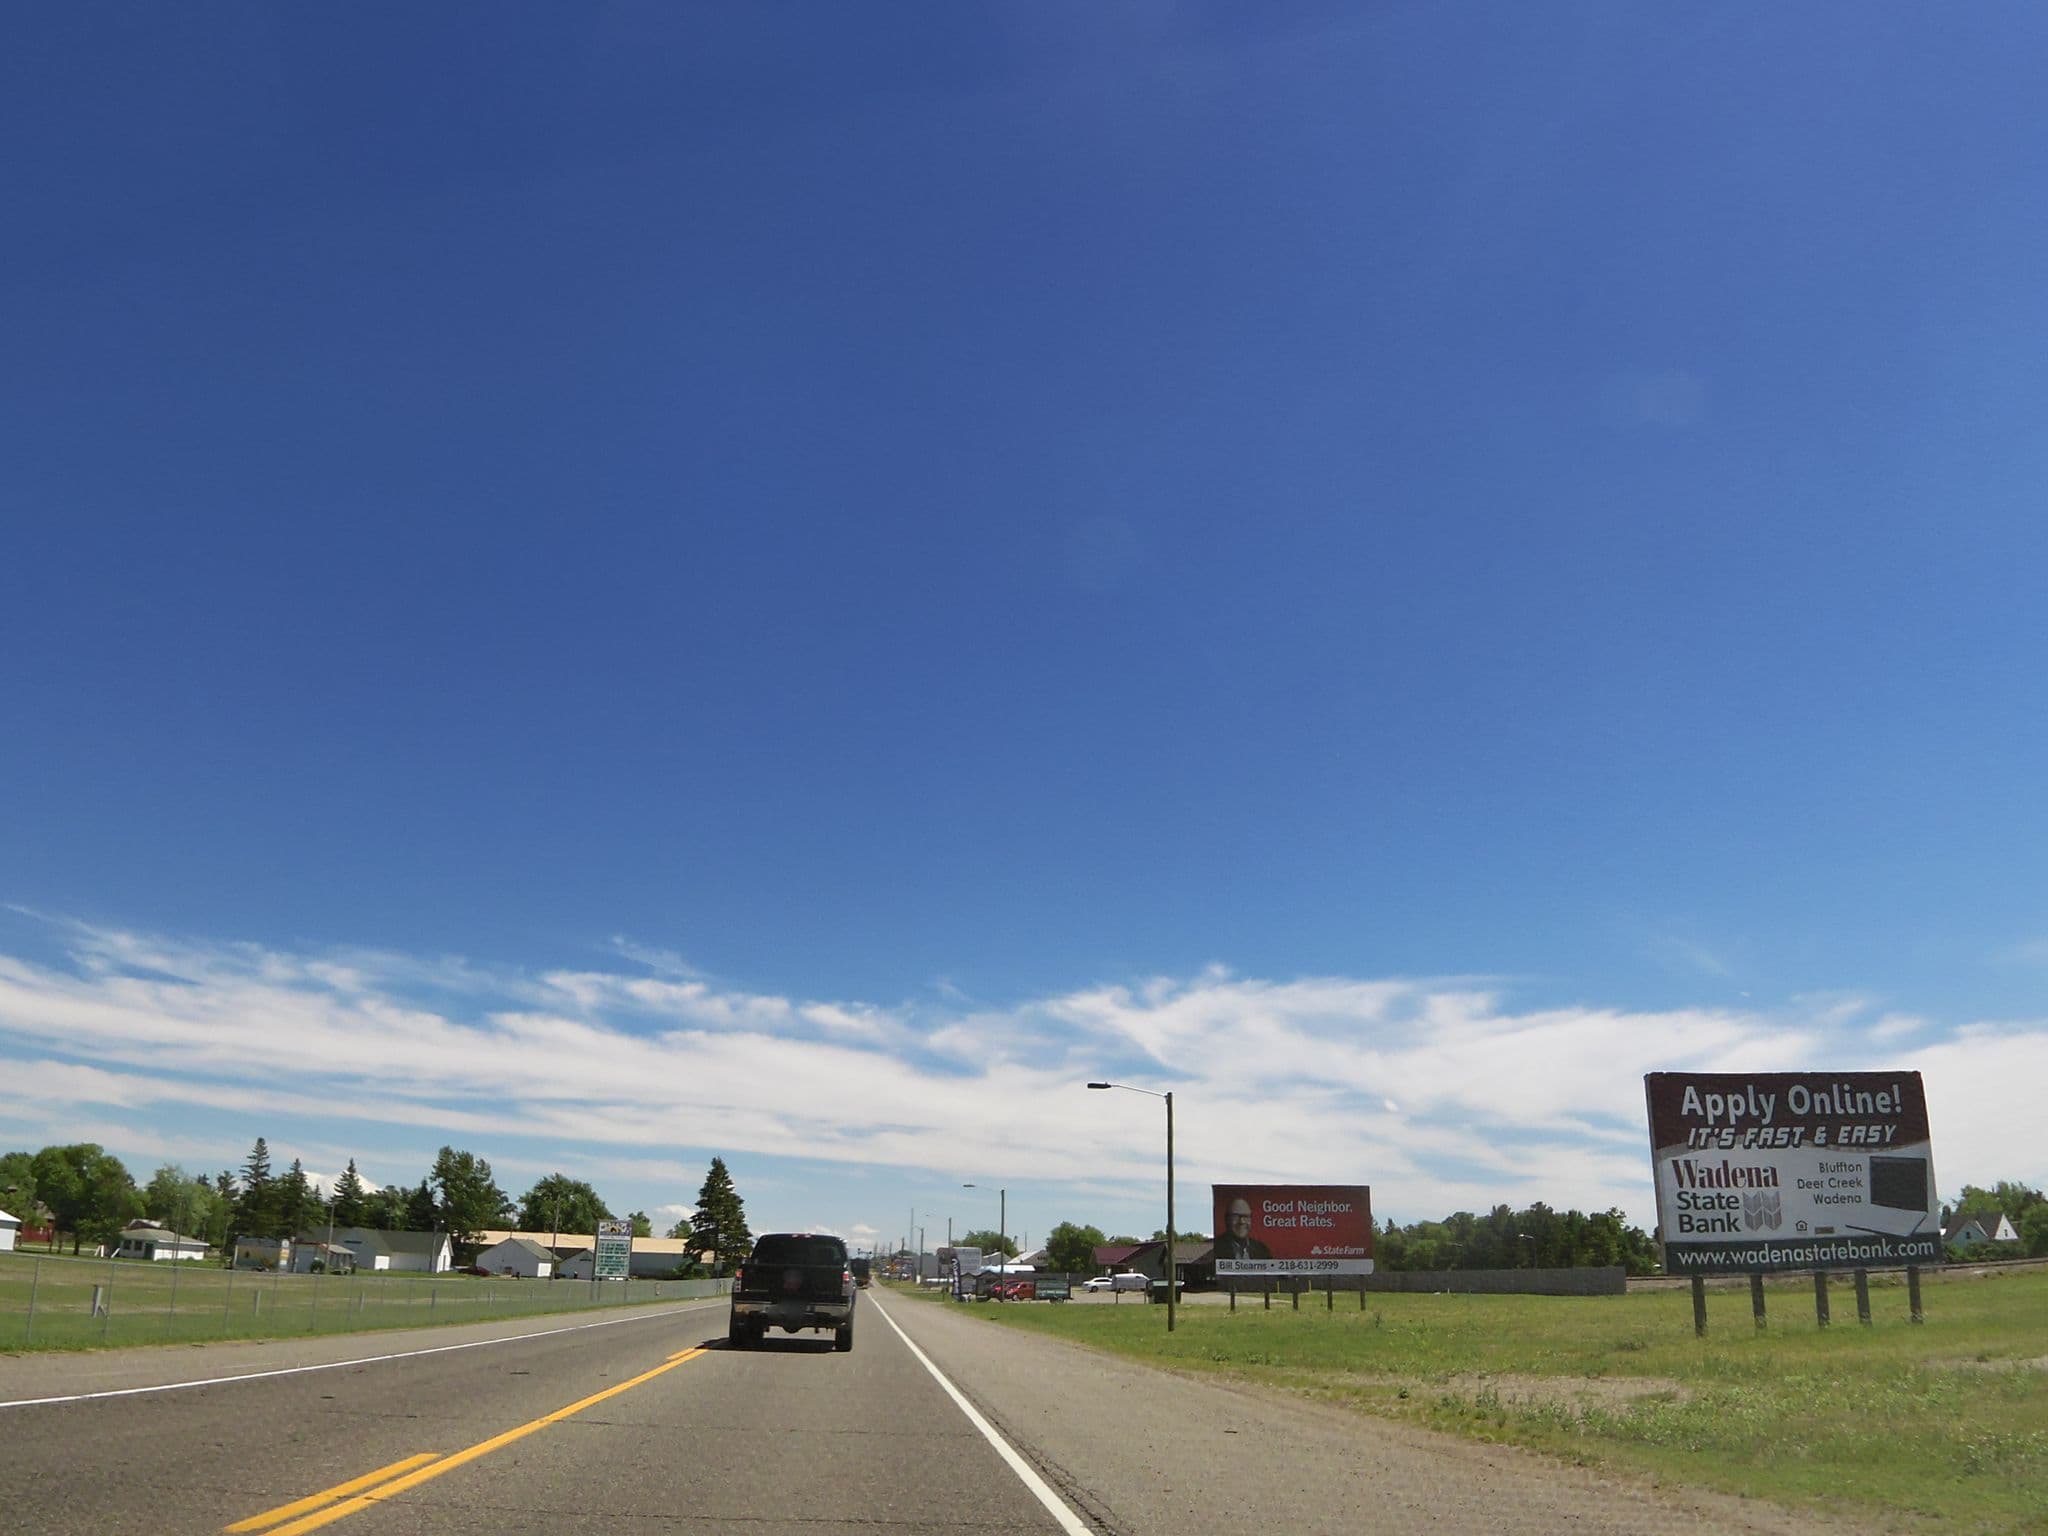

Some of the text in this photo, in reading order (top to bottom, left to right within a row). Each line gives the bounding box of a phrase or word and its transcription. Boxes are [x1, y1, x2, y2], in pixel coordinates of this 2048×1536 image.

[1681, 1084, 1903, 1125] Apply Online!
[1687, 1125, 1897, 1148] IT'S FAST & EASY
[1671, 1159, 1780, 1189] Wadena
[1818, 1162, 1863, 1174] Bluffton
[1796, 1177, 1864, 1190] Deer Creek
[1262, 1200, 1352, 1215] Good Neighbor.
[1676, 1191, 1740, 1211] State
[1813, 1193, 1862, 1205] Wadena
[1262, 1215, 1336, 1228] Great Rates.
[1678, 1212, 1741, 1233] Bank
[1678, 1238, 1934, 1265] www.wadenastatebank.com
[1218, 1261, 1233, 1270] Bill
[1234, 1261, 1268, 1271] Stearns
